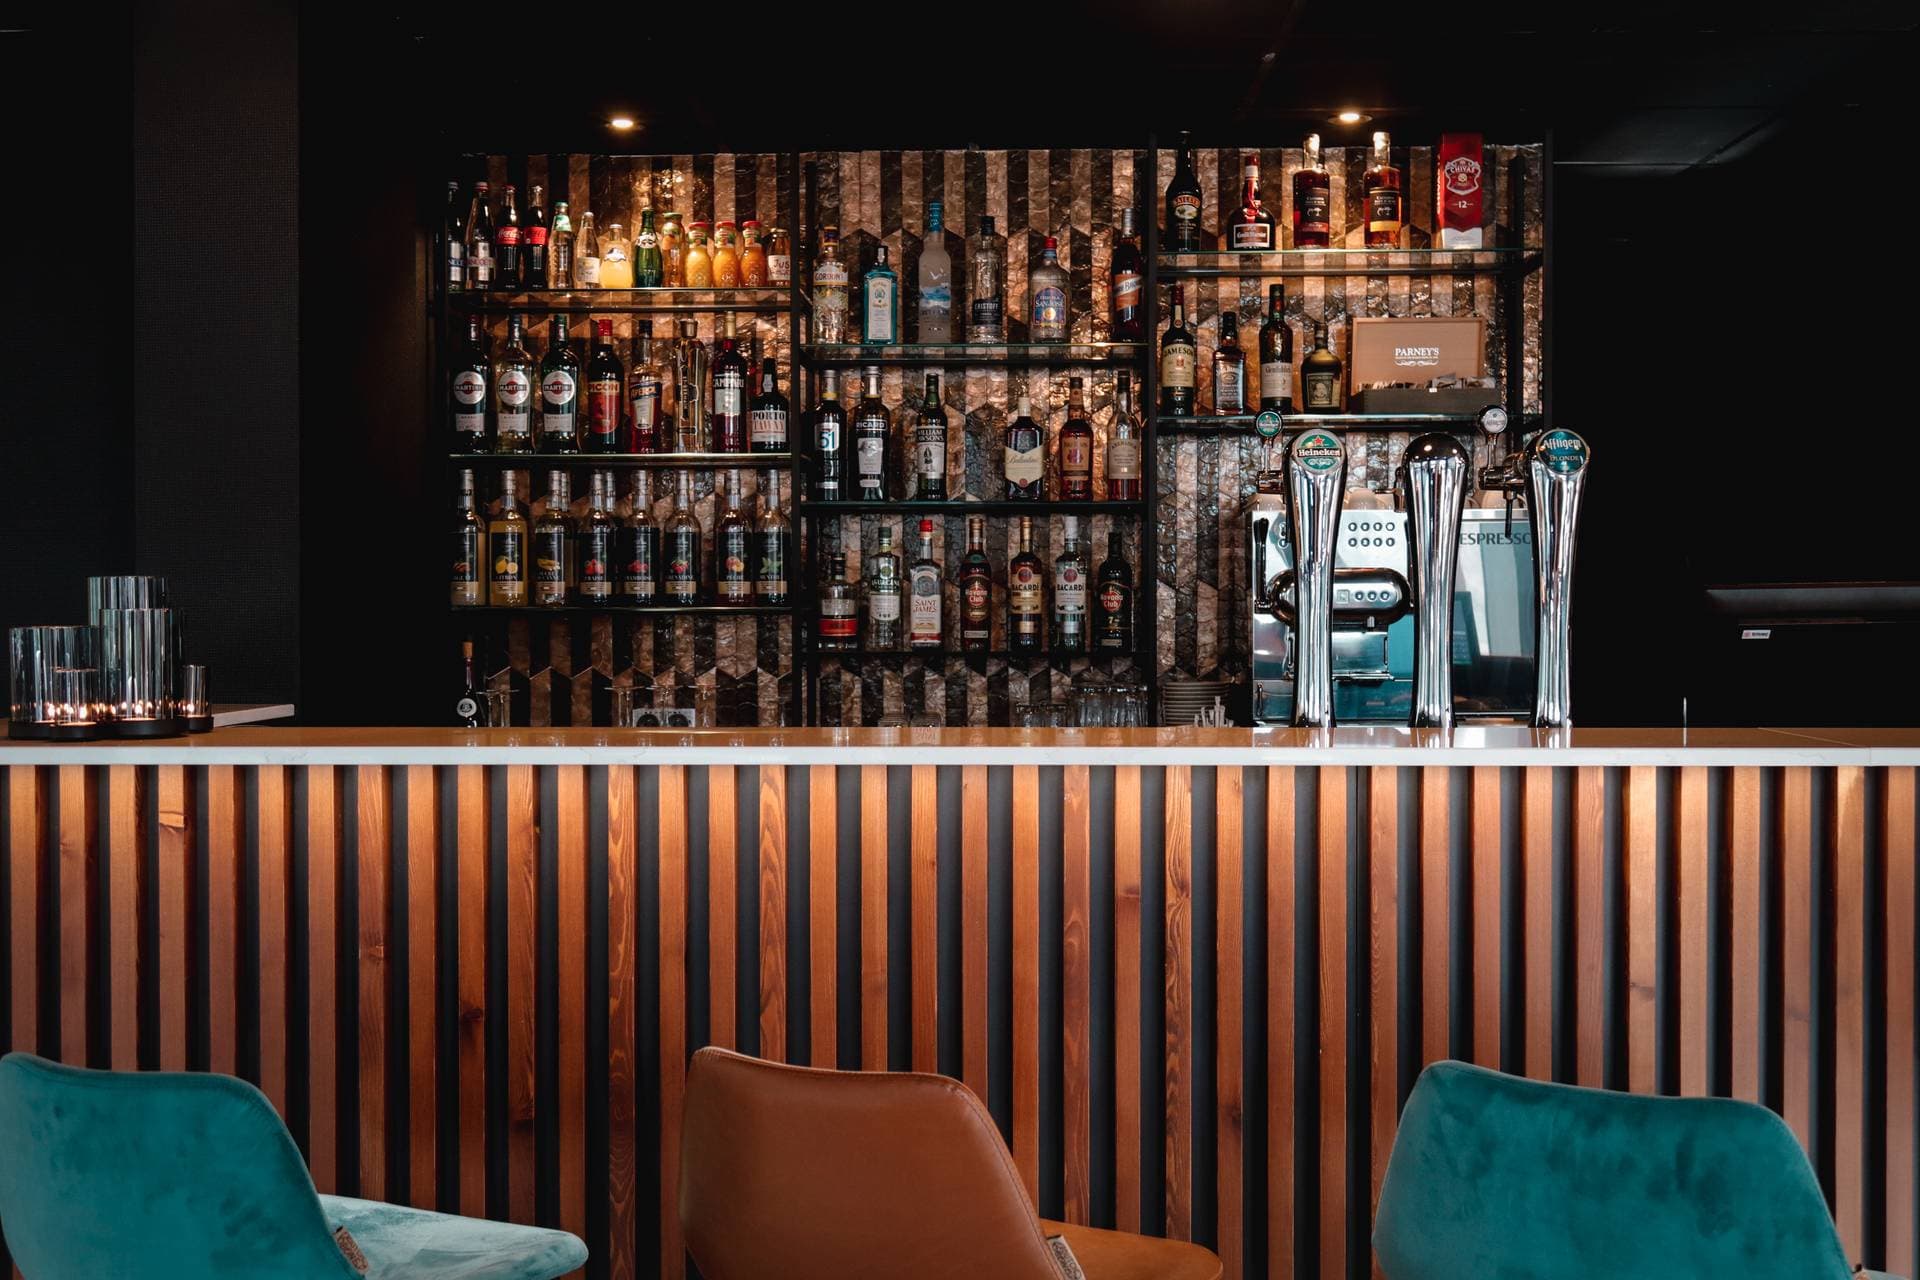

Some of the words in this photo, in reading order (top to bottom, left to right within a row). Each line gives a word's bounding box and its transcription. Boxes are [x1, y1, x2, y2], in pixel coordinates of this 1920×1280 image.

[1451, 165, 1475, 173] CHIVAS
[1458, 200, 1468, 208] 12
[1395, 347, 1440, 356] PARNEY'S
[753, 411, 785, 421] PORTO
[820, 431, 835, 449] 51
[1298, 448, 1341, 456] Heineken
[1103, 600, 1119, 608] Club
